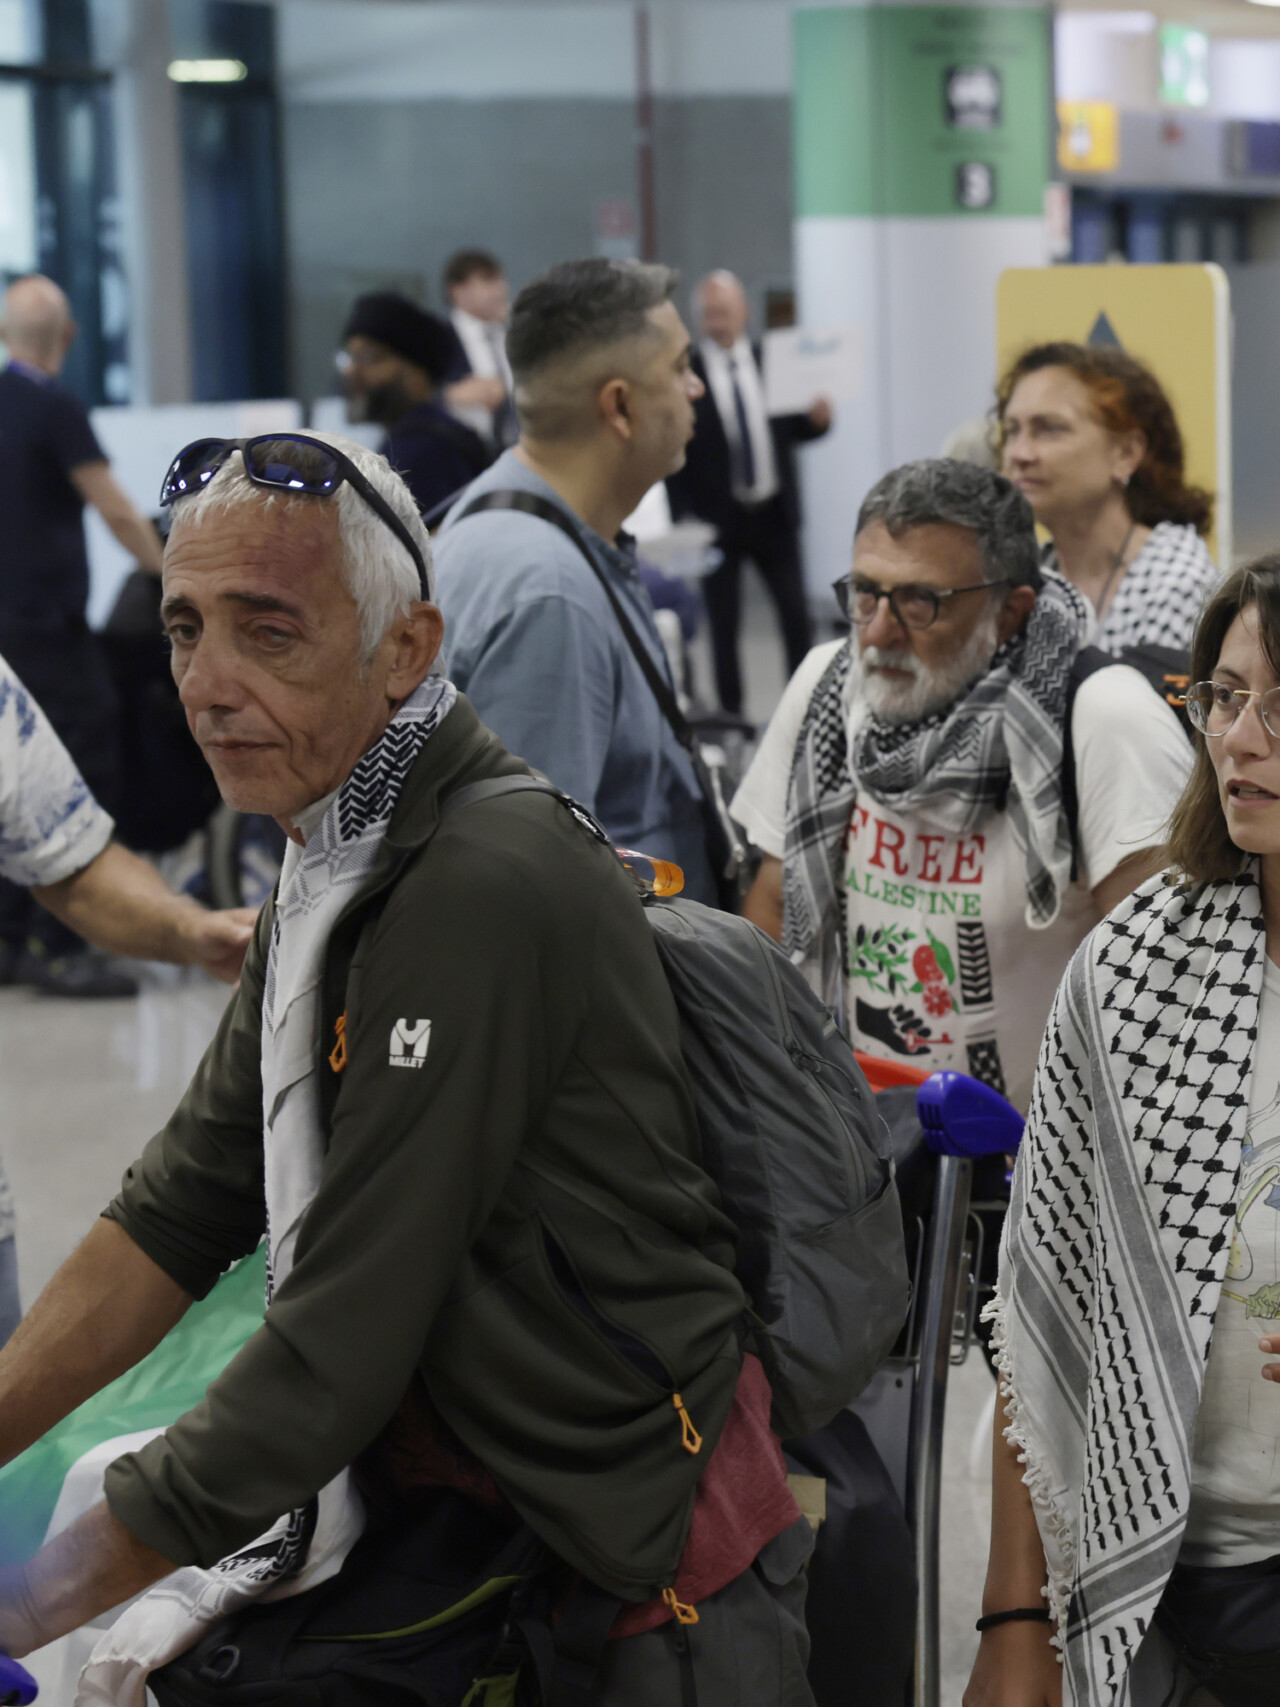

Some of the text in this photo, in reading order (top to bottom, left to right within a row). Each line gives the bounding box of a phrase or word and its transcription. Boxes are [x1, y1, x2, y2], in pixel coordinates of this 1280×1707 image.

[842, 803, 985, 884] FREE
[844, 867, 982, 917] ALESINE
[389, 1055, 426, 1069] MILLET
